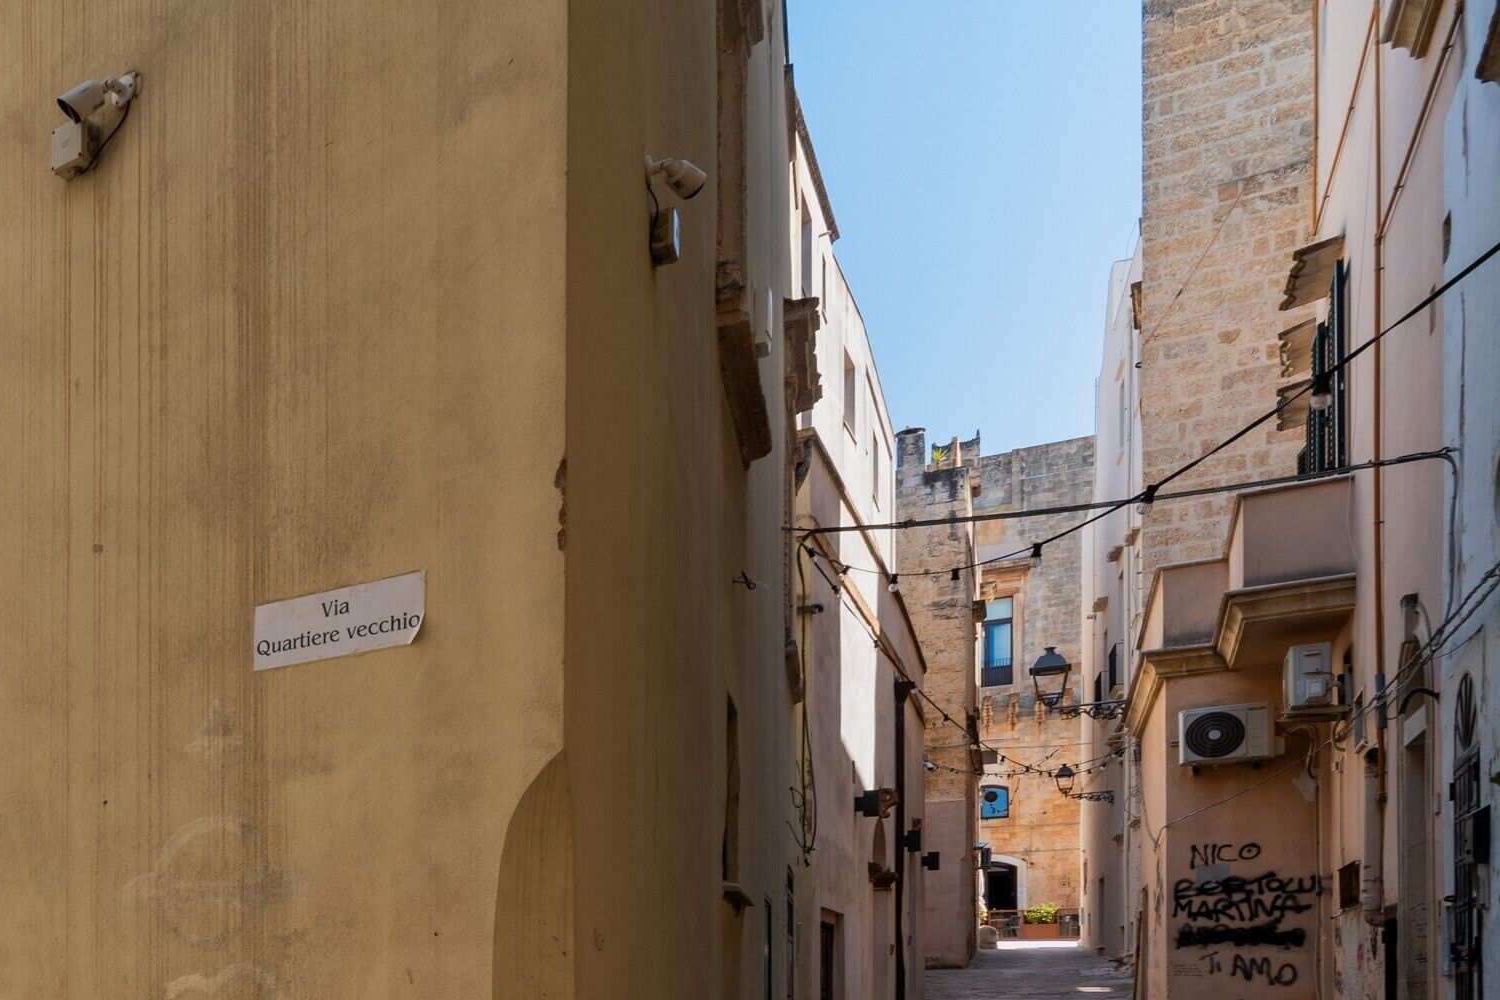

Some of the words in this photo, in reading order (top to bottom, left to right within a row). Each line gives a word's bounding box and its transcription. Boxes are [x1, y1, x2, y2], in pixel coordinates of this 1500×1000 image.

[321, 599, 350, 618] Via
[256, 629, 340, 656] Quartiere
[346, 612, 421, 640] vecchio
[1189, 842, 1262, 870] NICO
[1230, 953, 1299, 987] AMO
